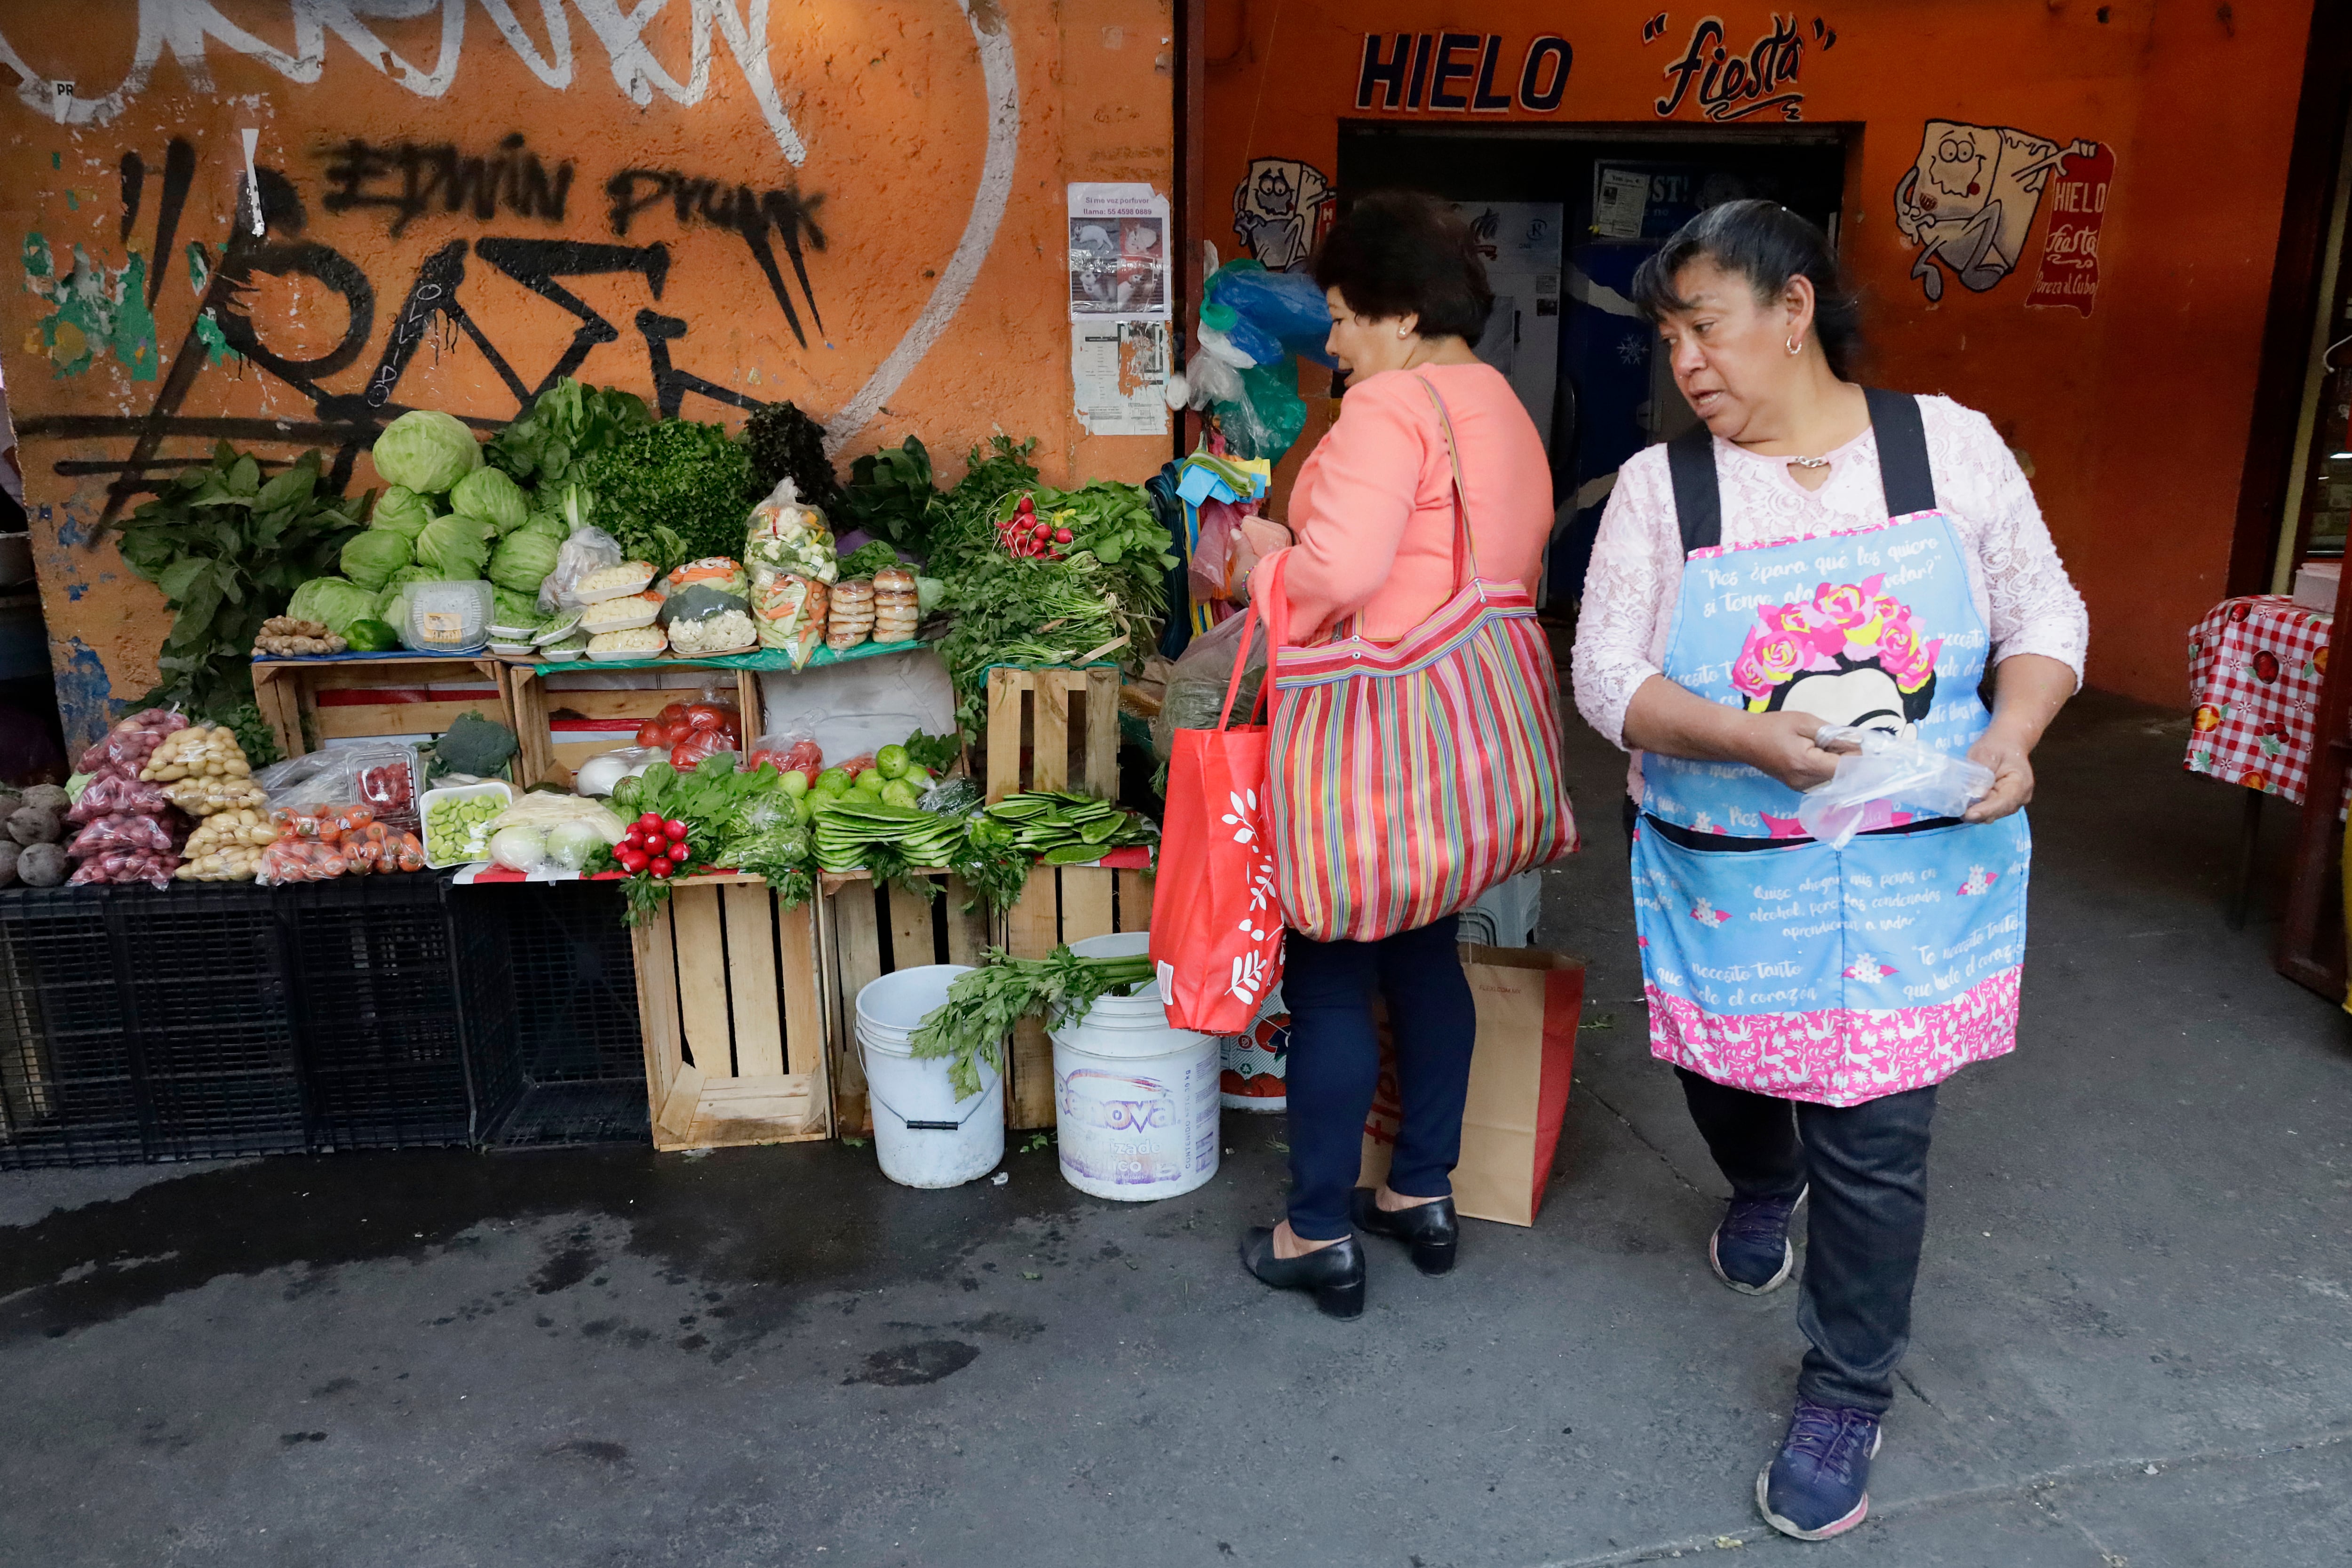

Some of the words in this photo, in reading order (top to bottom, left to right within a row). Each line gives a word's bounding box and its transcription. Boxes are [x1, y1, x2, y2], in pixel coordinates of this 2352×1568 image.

[1355, 31, 1573, 113] HIELO
[2054, 182, 2106, 212] HIELO
[2072, 274, 2096, 294] Cubo
[1858, 545, 1880, 566] los
[1887, 537, 1939, 562] quiero
[1703, 600, 1716, 618] si
[1784, 583, 1814, 604] ala
[1850, 873, 1873, 888] mis
[1657, 967, 1685, 987] que
[1692, 962, 1753, 983] necesito
[1903, 983, 1933, 1002] que
